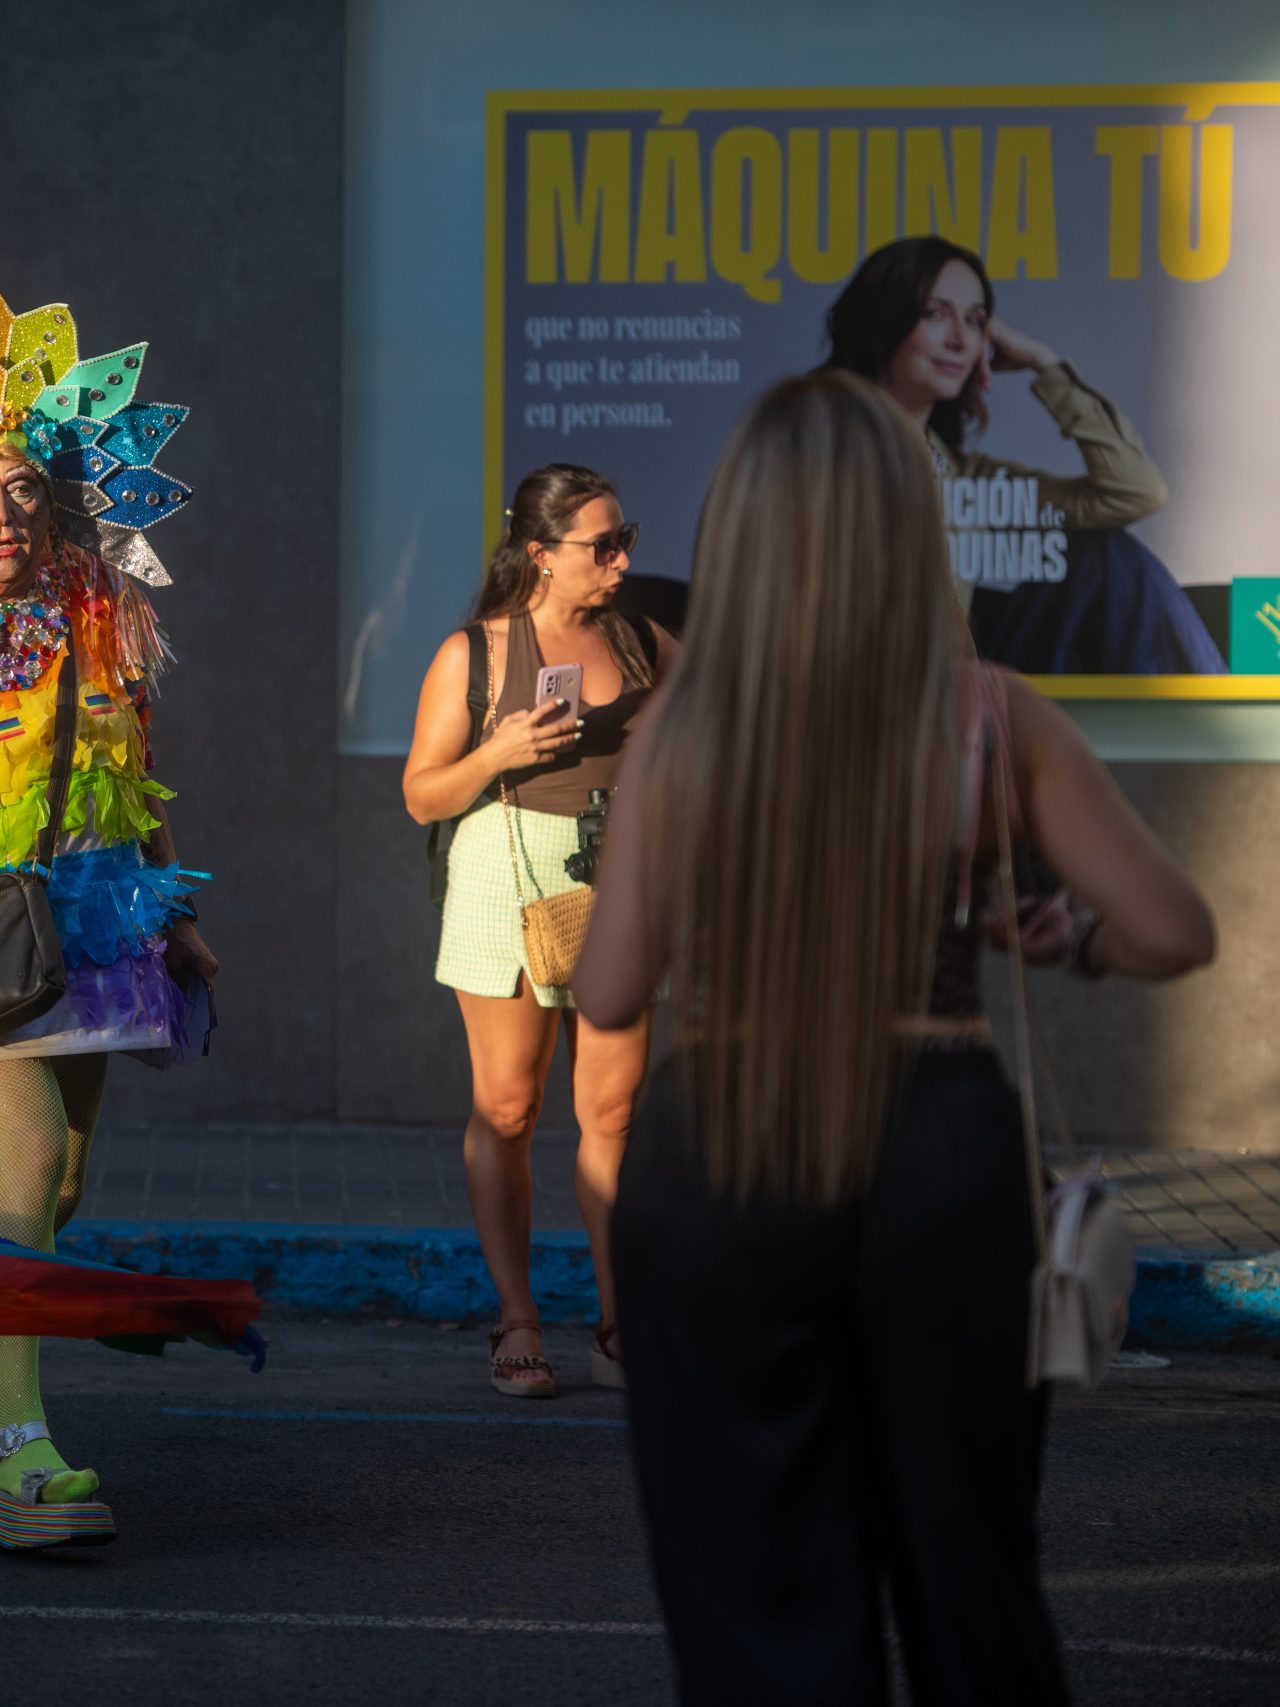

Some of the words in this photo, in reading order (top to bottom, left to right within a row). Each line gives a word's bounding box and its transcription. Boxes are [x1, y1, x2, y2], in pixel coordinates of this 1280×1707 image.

[526, 106, 1058, 304] MÁQUINA
[1095, 102, 1234, 282] TÚ
[524, 315, 573, 350] que
[577, 315, 610, 341] no
[614, 308, 742, 341] renuncias
[524, 359, 541, 384] a
[545, 359, 593, 393] que
[598, 354, 624, 384] te
[628, 350, 741, 384] atiendan
[524, 402, 556, 428] en
[560, 402, 672, 436] persona.
[1039, 501, 1066, 528] de
